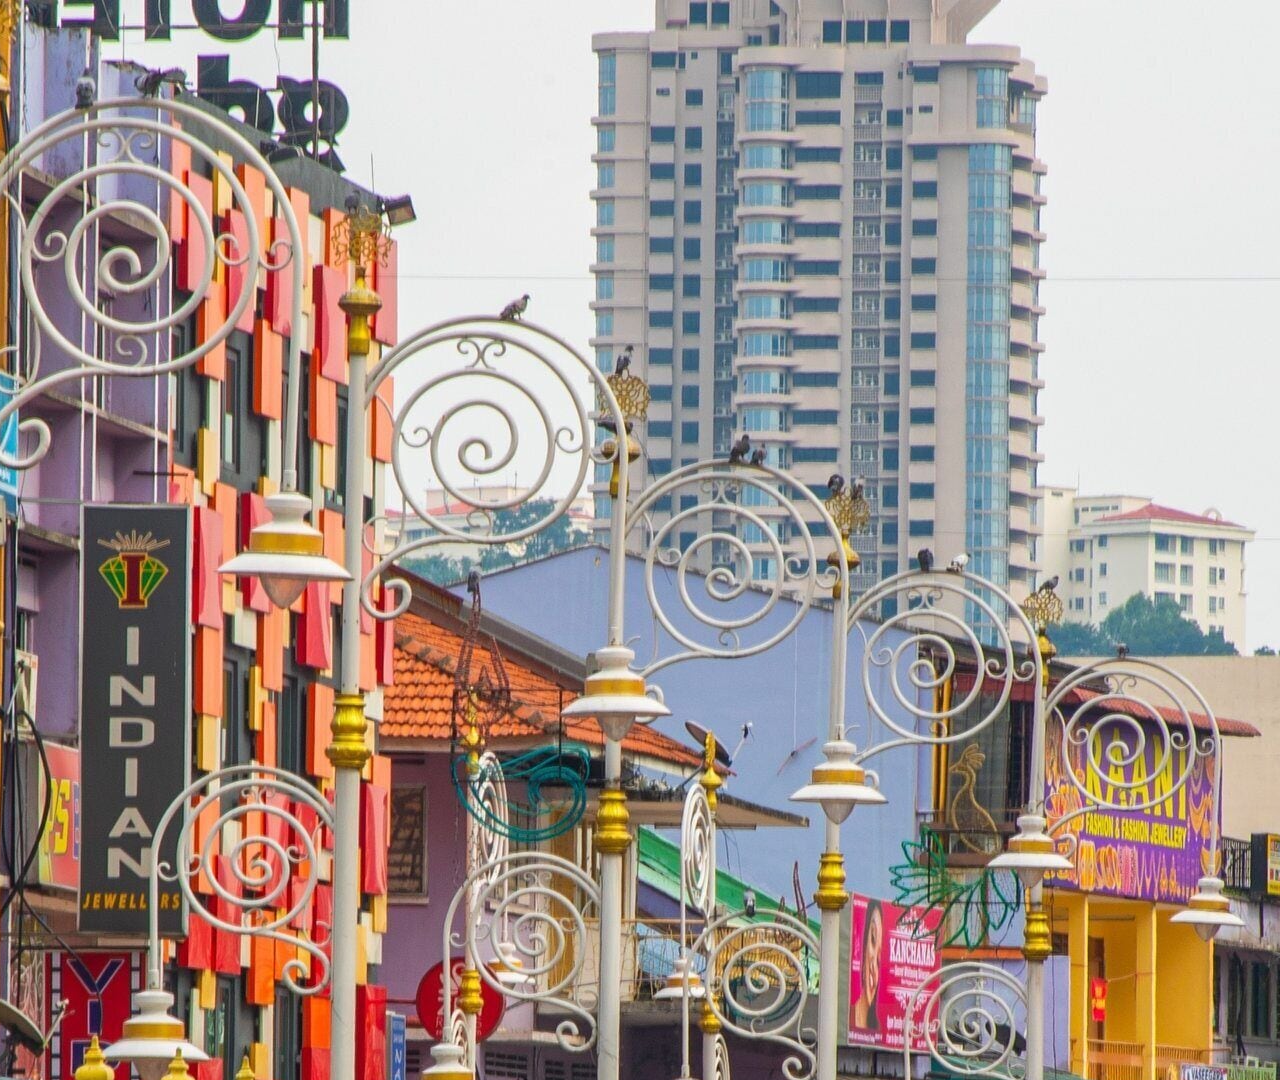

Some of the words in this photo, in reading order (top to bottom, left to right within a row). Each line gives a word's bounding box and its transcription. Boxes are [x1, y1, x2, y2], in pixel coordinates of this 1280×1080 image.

[107, 626, 156, 880] INDIAN
[1086, 812, 1114, 838] FASHION
[1121, 821, 1149, 844] FASHION
[82, 892, 181, 911] JEWELLRS
